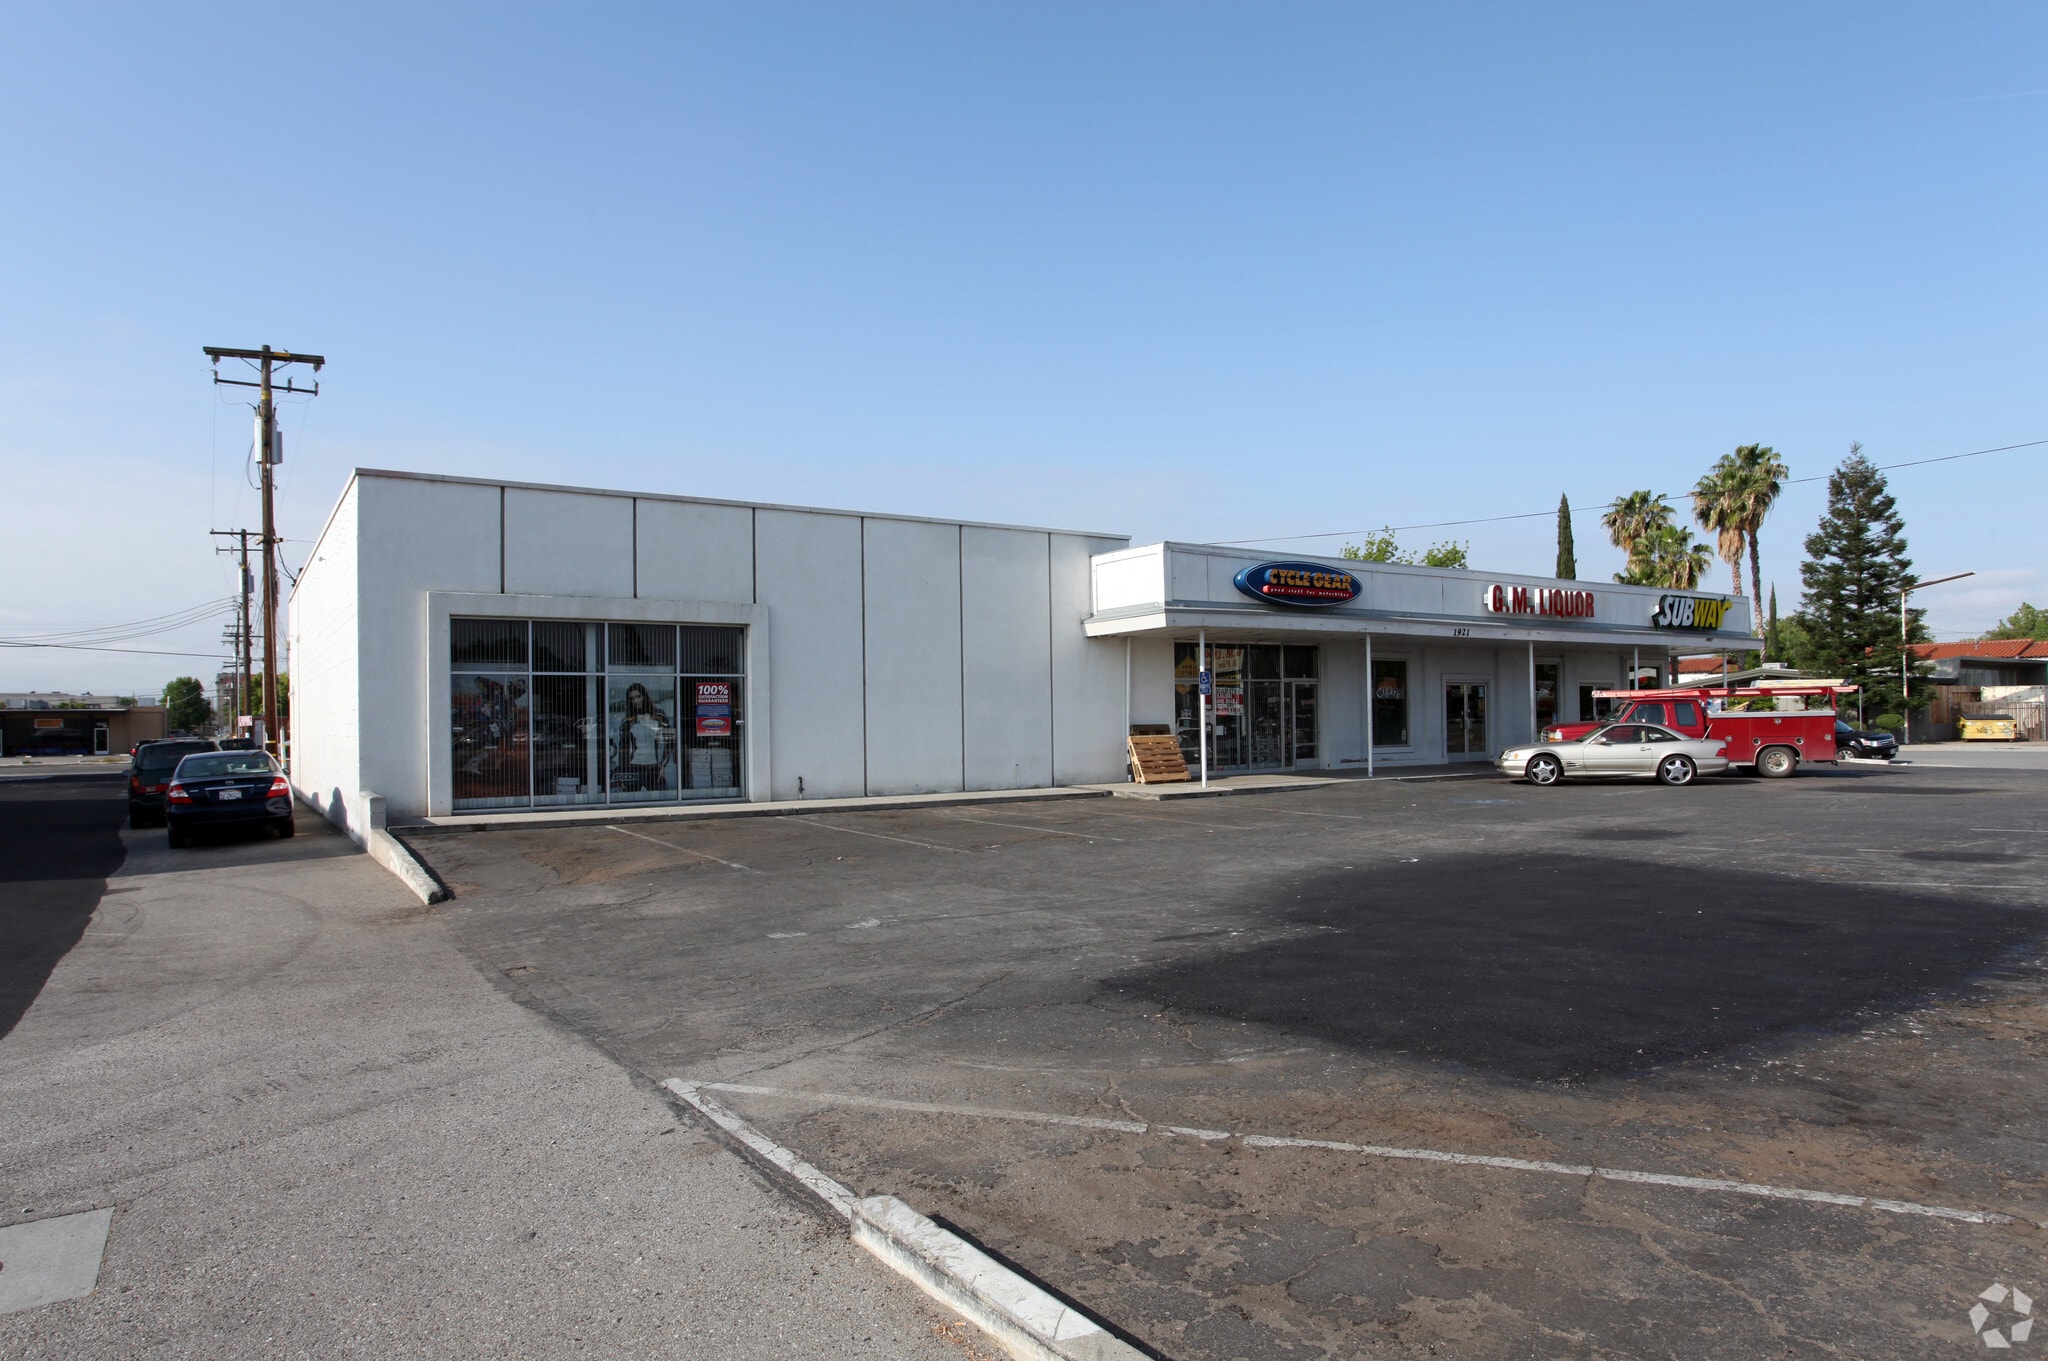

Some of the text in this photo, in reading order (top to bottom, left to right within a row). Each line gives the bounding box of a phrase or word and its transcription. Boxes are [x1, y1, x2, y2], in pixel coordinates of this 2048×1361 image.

[1269, 568, 1352, 589] CYCLE GEAR
[1490, 585, 1595, 618] G.M. LIQUOR
[1658, 596, 1733, 628] SUBWAY
[1453, 628, 1470, 636] 1921
[698, 685, 729, 695] 100%
